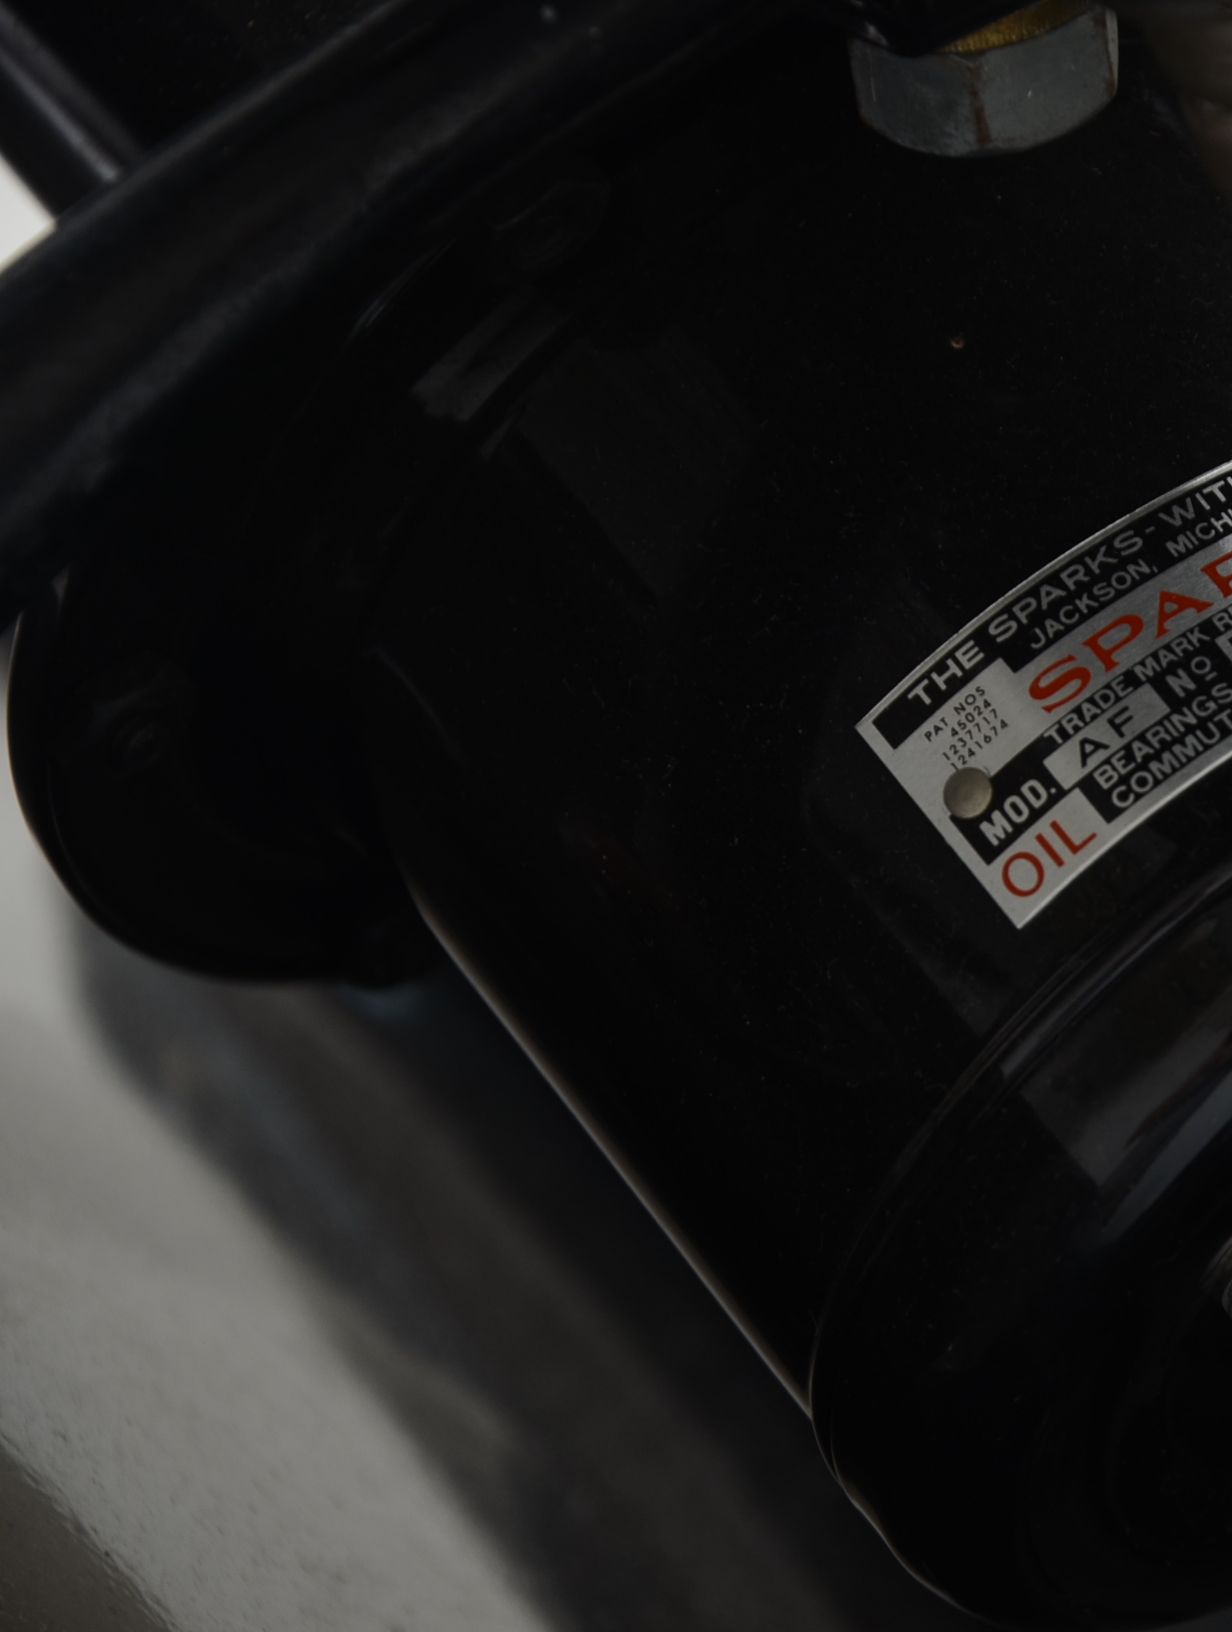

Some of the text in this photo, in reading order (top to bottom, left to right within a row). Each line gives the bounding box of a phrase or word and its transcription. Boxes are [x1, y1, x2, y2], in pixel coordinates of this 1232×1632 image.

[1030, 559, 1158, 649] JACKSON,
[907, 640, 985, 707] THE
[1043, 674, 1135, 746] TRADE
[1133, 626, 1210, 682] MARK
[924, 686, 985, 742] PAT NOS
[942, 708, 997, 760] 1237717
[950, 719, 1009, 771] 1241674
[951, 699, 991, 738] 45024
[979, 778, 1057, 847] MOD.
[1001, 820, 1097, 897] OIL
